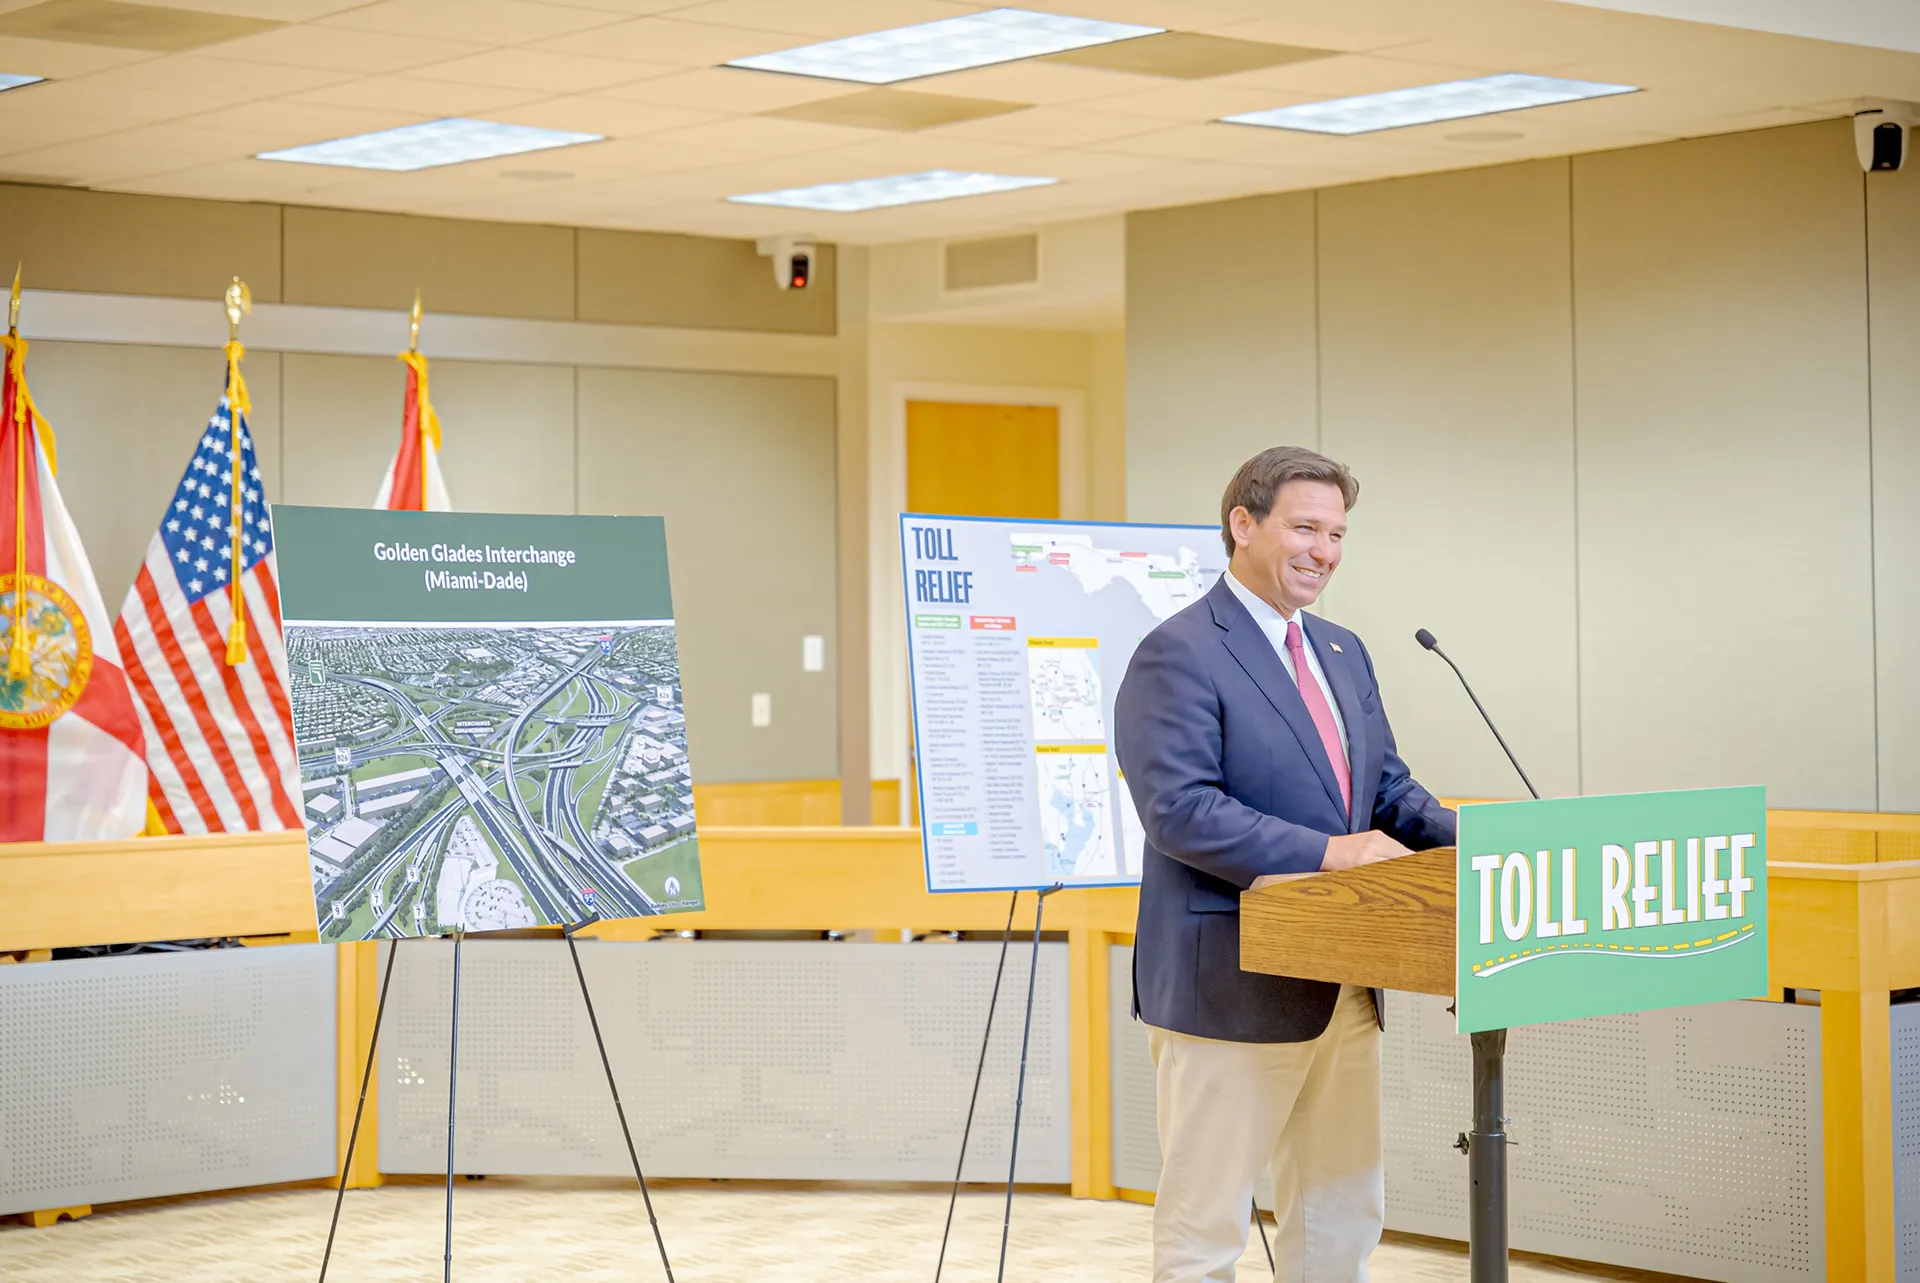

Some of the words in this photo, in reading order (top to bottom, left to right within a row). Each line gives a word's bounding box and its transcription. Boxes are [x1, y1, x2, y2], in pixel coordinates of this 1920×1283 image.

[373, 542, 429, 562] Golden
[431, 543, 483, 563] Glades
[485, 545, 576, 567] Interchange
[911, 526, 958, 561] TOLL
[424, 569, 528, 592] (Miami-Dade)
[915, 569, 973, 604] RELIEF
[600, 641, 611, 651] 95
[583, 893, 594, 903] 95
[1471, 847, 1588, 945] TOLL
[1601, 833, 1756, 931] RELIEF
